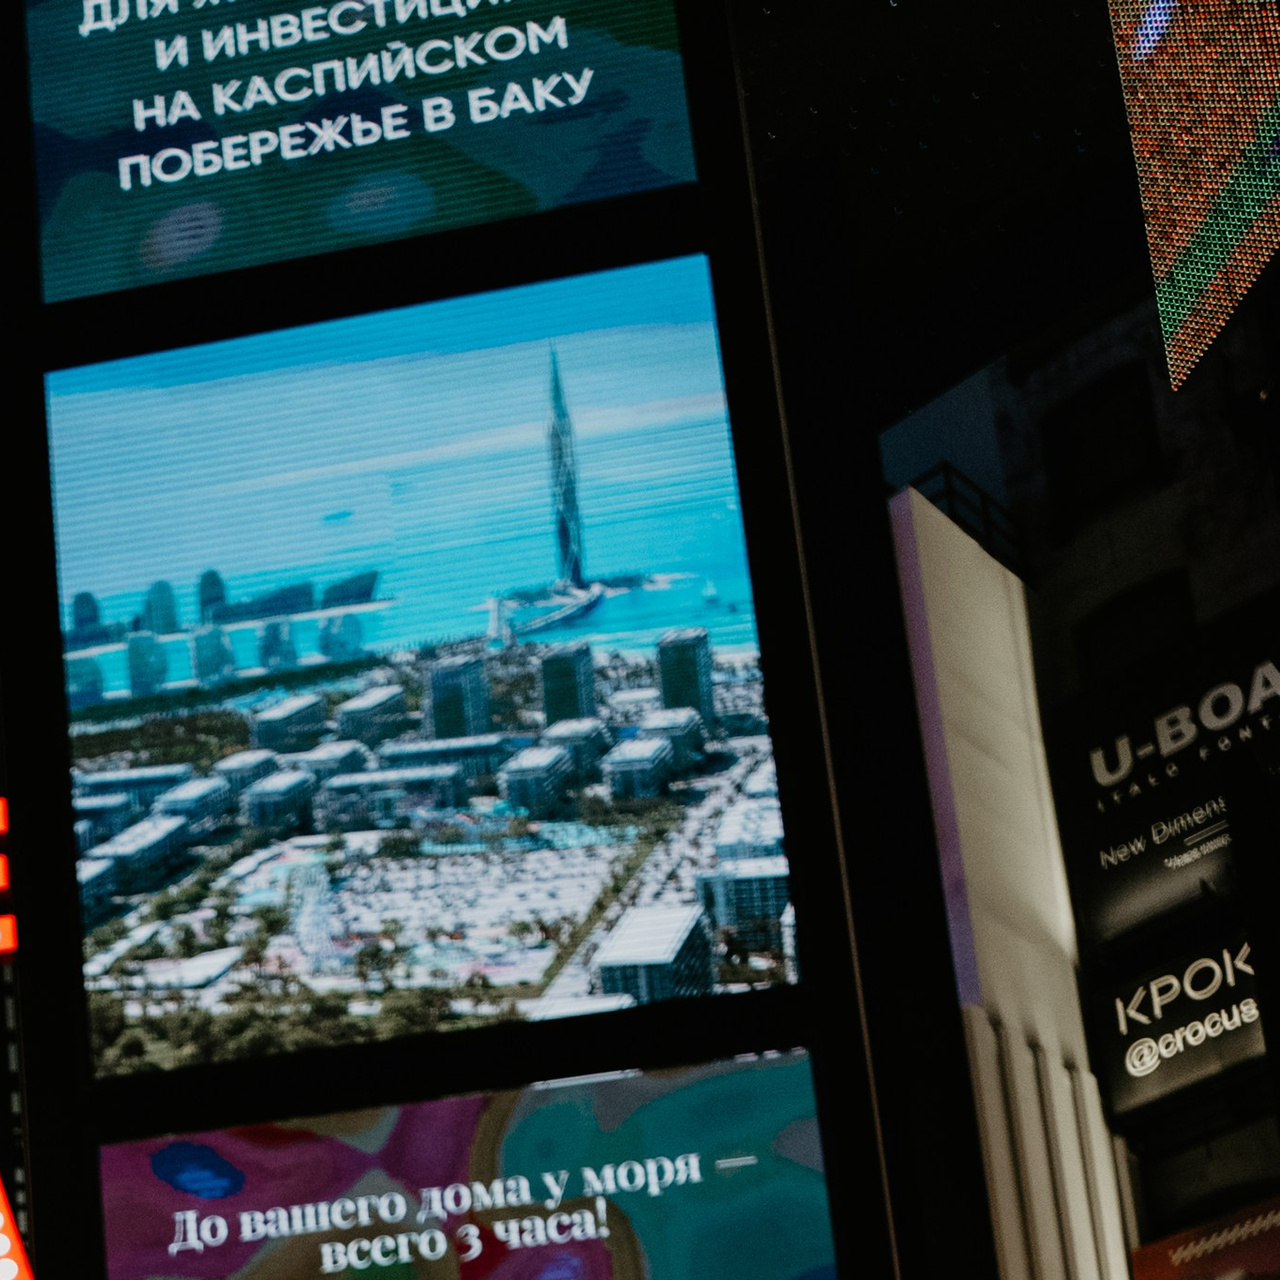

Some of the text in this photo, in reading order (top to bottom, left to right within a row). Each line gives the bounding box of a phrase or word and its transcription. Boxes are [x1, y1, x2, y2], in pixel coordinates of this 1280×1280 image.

[132, 15, 569, 131] НА КАСПИЙСКОМ
[154, 34, 189, 71] И
[118, 68, 594, 191] ПОБЕРЕЖЬЕ В БАКУ
[1099, 835, 1147, 869] New
[1114, 940, 1256, 1036] КРОК
[1125, 998, 1261, 1078] @crocus
[167, 1209, 229, 1256] До
[239, 1190, 408, 1243] вашего
[417, 1175, 530, 1227] дома
[543, 1171, 570, 1209] у
[581, 1152, 702, 1197] моря
[319, 1196, 611, 1274] всего 3 часа!
